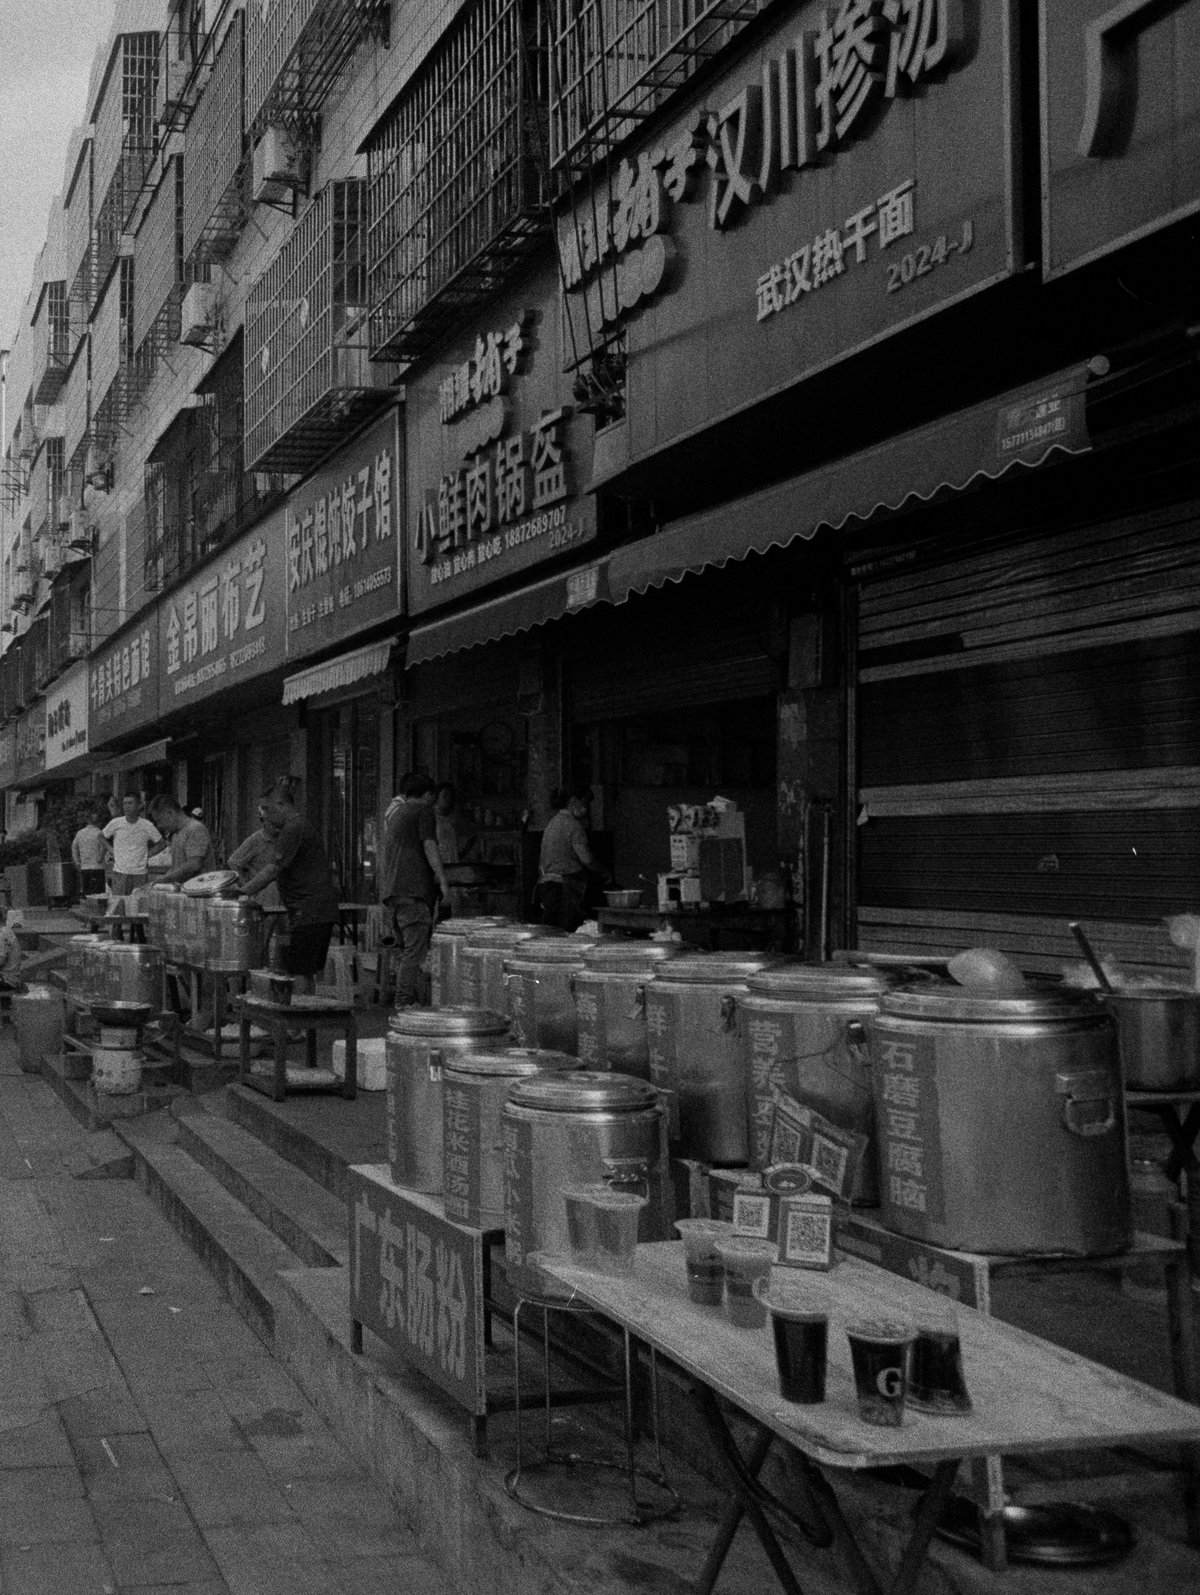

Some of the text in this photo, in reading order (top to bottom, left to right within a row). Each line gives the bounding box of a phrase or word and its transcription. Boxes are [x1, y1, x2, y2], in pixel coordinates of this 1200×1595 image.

[756, 179, 917, 321] 武汉热干面
[414, 408, 568, 564] 小鲜肉锅盔
[880, 1039, 928, 1213] 石磨豆腐脑
[354, 1191, 468, 1381] 广东肠粉
